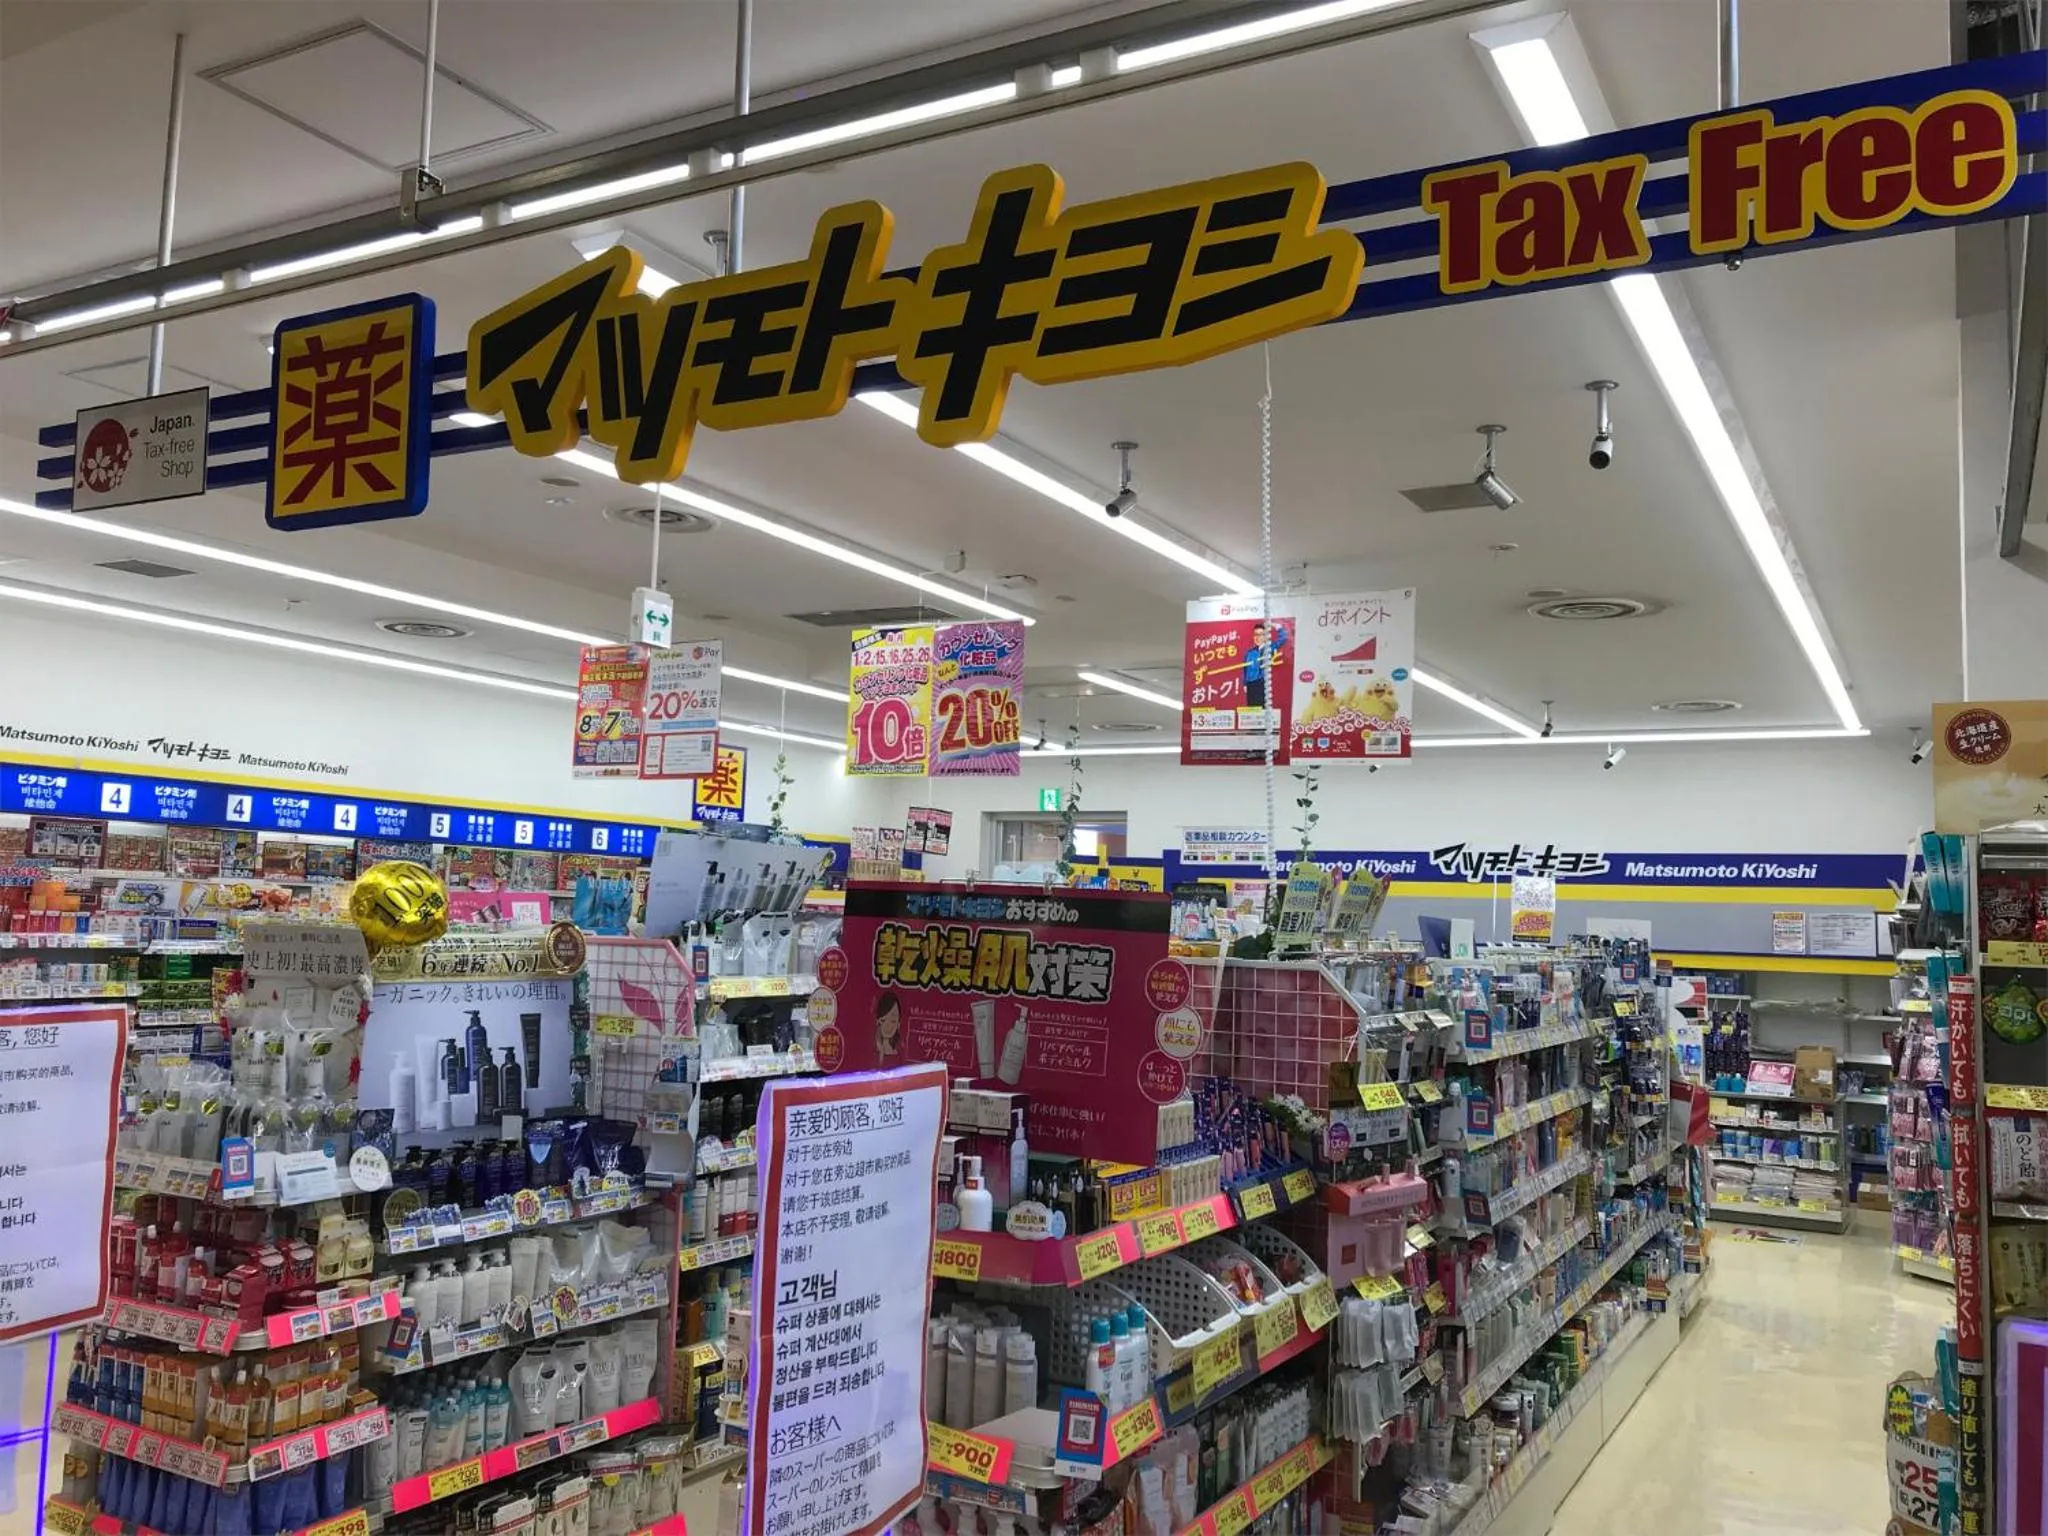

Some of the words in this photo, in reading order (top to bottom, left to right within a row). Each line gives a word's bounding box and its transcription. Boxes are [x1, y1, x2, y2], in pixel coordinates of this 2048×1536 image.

[1430, 164, 1640, 285] Tax
[1700, 101, 2006, 245] Free
[480, 186, 1333, 462] マツモトキヨシ
[282, 320, 405, 506] 薬
[143, 438, 195, 460] Tax-free
[160, 457, 195, 480] Shop
[1318, 606, 1392, 627] dポイント
[938, 631, 1020, 658] カウンセリング
[1193, 646, 1238, 664] いつでも
[959, 650, 998, 667] 化粧品
[649, 690, 698, 721] 20%
[579, 715, 592, 734] 8
[603, 711, 621, 735] 7
[853, 697, 925, 765] 10倍
[938, 688, 1019, 753] 20%
[993, 720, 1020, 743] OFF
[0, 725, 84, 747] Matsumoto
[87, 735, 139, 753] KiYoshi
[147, 737, 231, 762] マツモトキヨシ
[238, 752, 307, 773] Matsumoto
[307, 761, 349, 777] KiYoshi
[702, 752, 739, 806] 薬
[108, 787, 123, 809] 4
[232, 798, 246, 819] 4
[339, 807, 351, 827] 4
[434, 816, 445, 834] 5
[519, 825, 529, 840] 5
[595, 831, 604, 846] 6
[1356, 859, 1417, 875] KiYoshi
[1431, 842, 1611, 882] マツモトキヨシ
[1625, 861, 1739, 879] Matsumoto
[1741, 861, 1818, 880] KiYoshi
[1005, 898, 1080, 924] おすすめの
[500, 952, 540, 974] No.1
[876, 921, 1113, 1001] 乾燥肌対策
[24, 1026, 60, 1045] 您好
[1950, 1000, 1969, 1101] 汗かいても
[878, 1096, 905, 1124] 您好
[786, 1140, 854, 1164] 对于您在旁边
[1952, 1120, 1972, 1211] 拭いても
[2015, 1133, 2037, 1179] のど飴
[939, 1248, 978, 1269] 1800
[777, 1269, 838, 1307] 고객님
[1956, 1232, 1979, 1341] 落ちにくい
[775, 1314, 802, 1336] 슈퍼
[804, 1305, 842, 1329] 상품에
[843, 1291, 882, 1318] 대해서는
[775, 1340, 802, 1361] 슈퍼
[804, 1322, 864, 1354] 계산대에서
[775, 1361, 814, 1387] 정산을
[815, 1339, 879, 1375] 부탁드립니다
[772, 1386, 811, 1413] 불편을
[812, 1378, 837, 1400] 드려
[839, 1360, 885, 1394] 죄송합니다
[769, 1413, 842, 1456] お客様へ
[1960, 1375, 1979, 1487] 塗り直しても
[953, 1442, 993, 1469] 900
